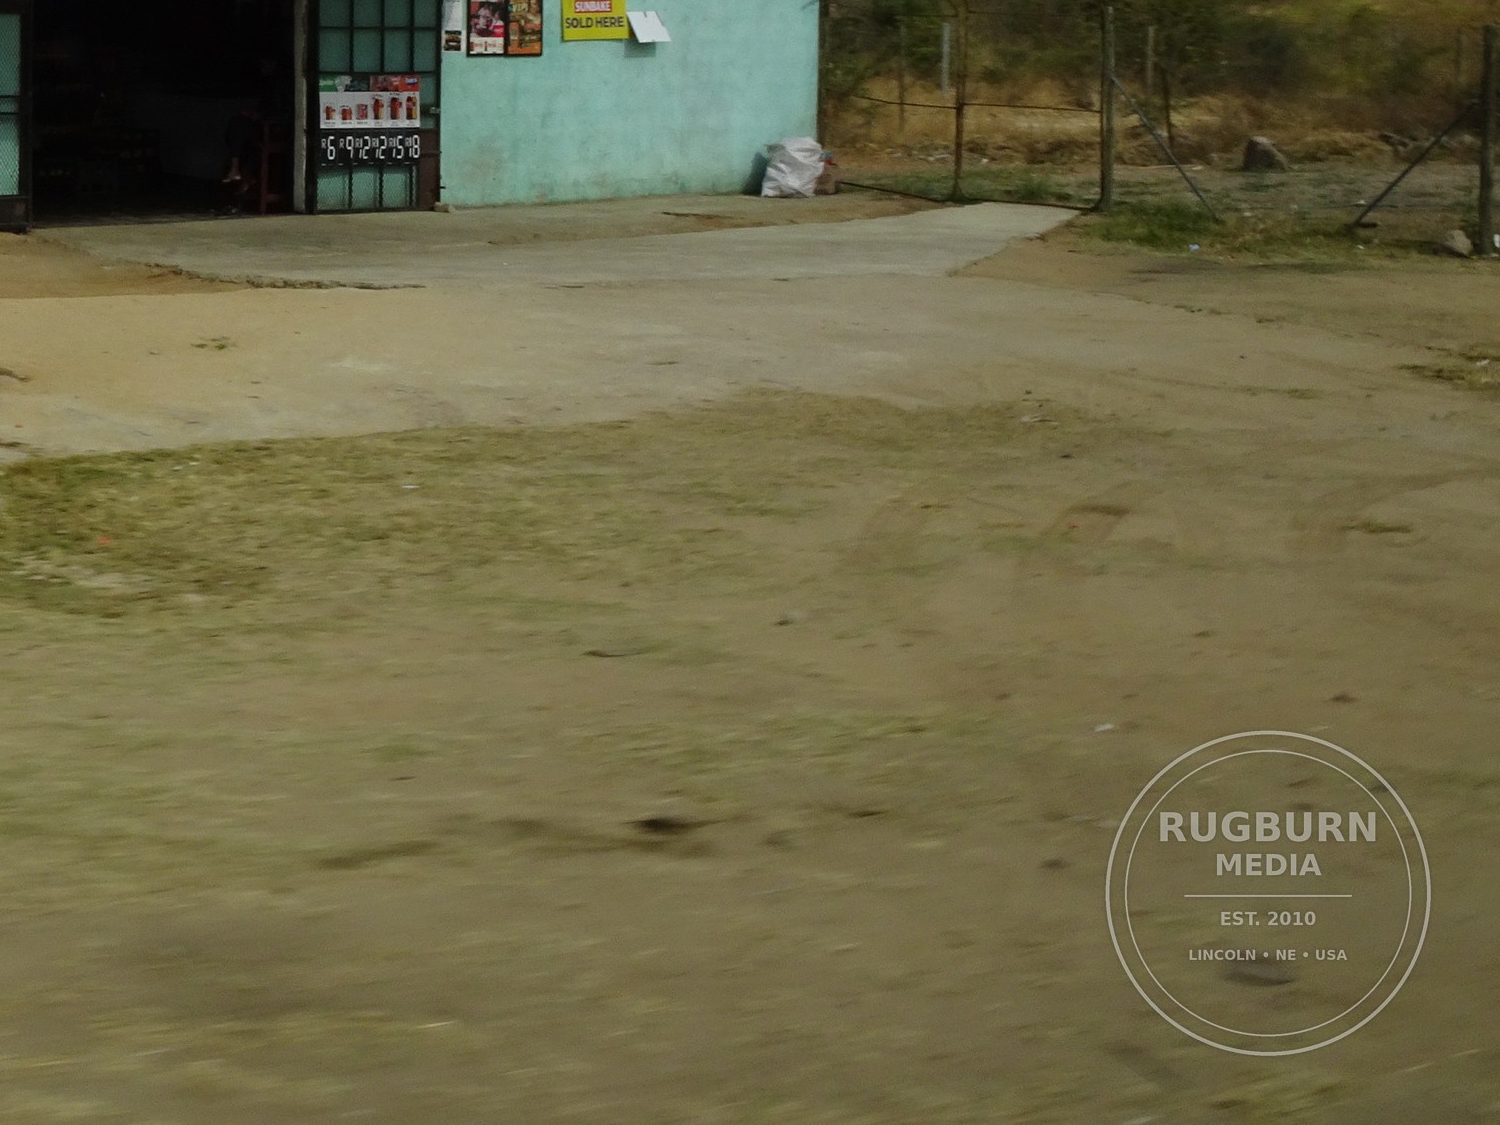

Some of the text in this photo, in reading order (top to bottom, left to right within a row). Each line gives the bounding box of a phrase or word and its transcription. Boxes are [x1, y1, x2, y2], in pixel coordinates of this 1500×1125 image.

[575, 0, 611, 12] SUNBAKE
[565, 16, 624, 28] SOLD HERE
